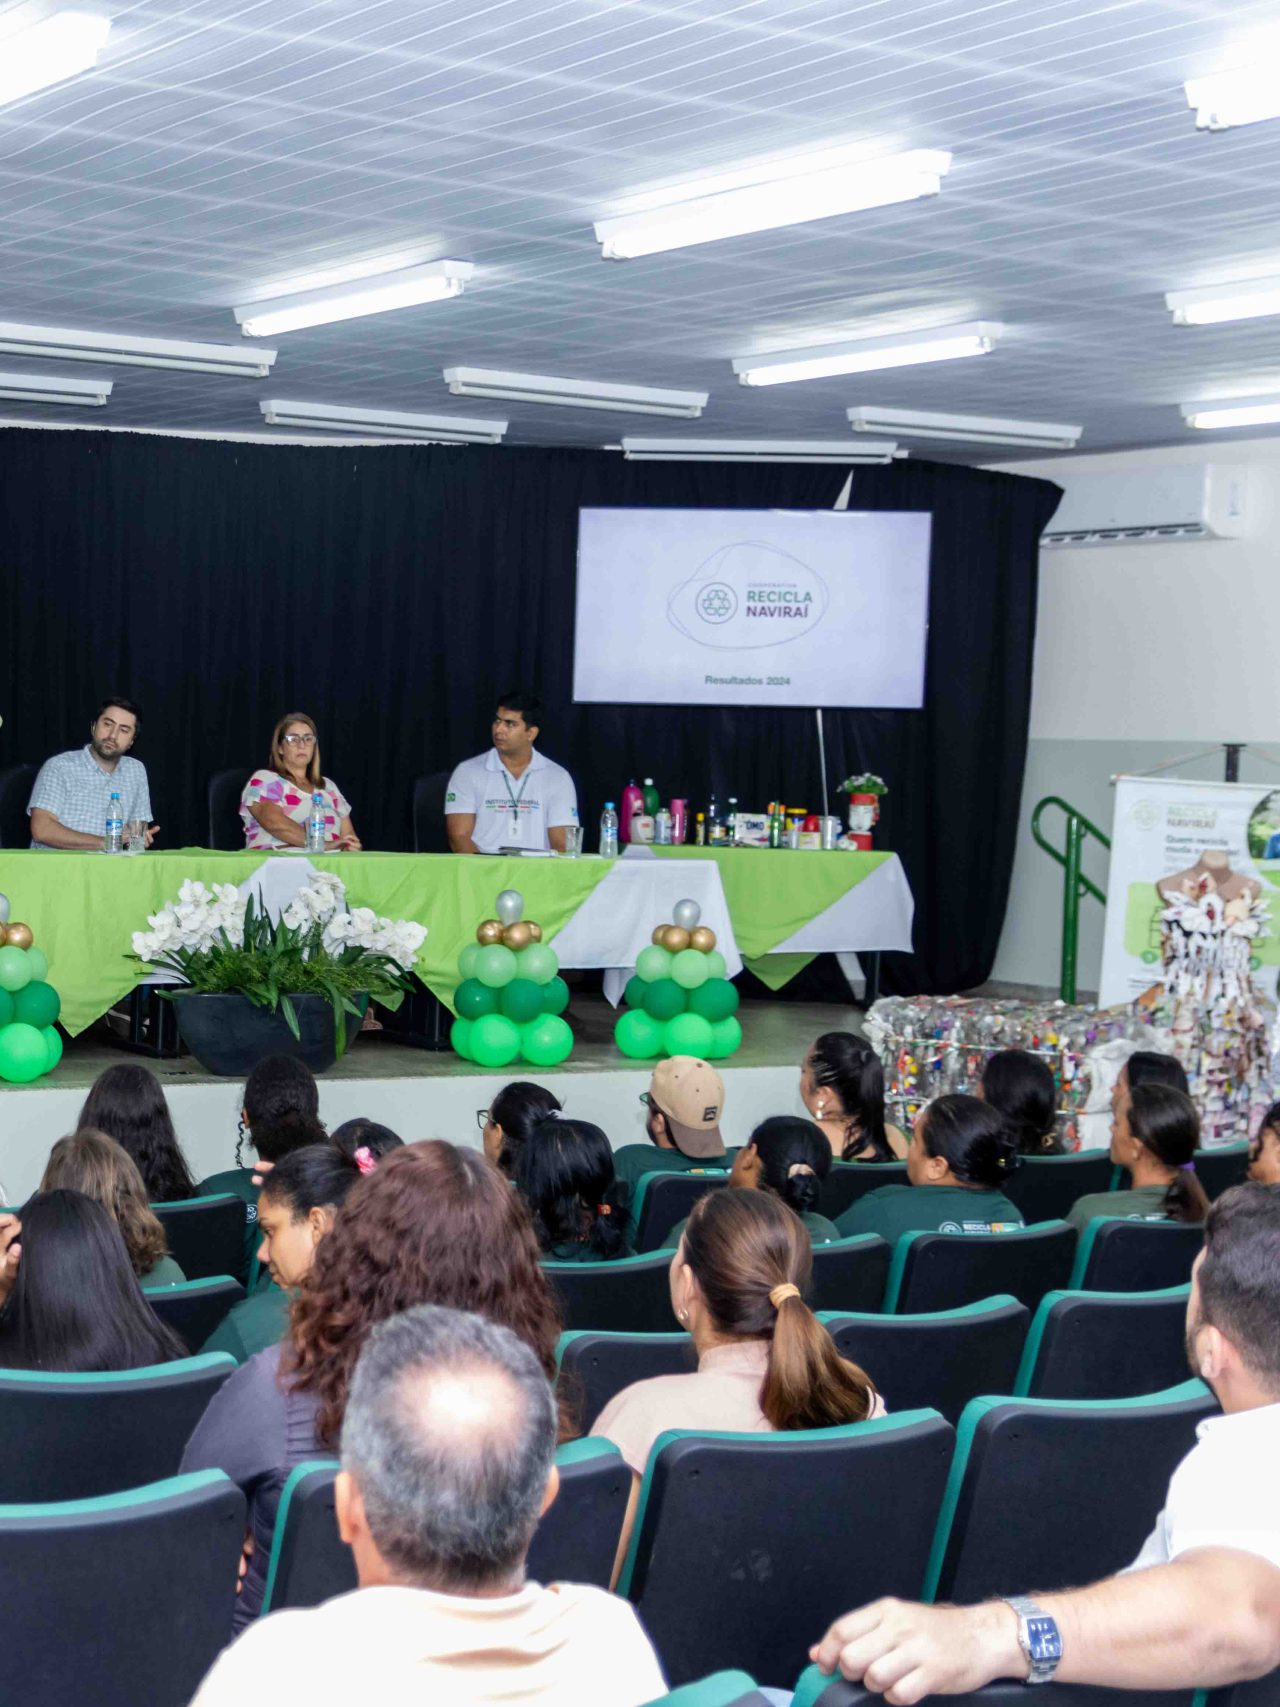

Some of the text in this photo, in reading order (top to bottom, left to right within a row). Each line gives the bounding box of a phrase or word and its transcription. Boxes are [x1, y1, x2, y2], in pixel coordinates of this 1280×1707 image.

[747, 590, 812, 603] RECICLA
[747, 604, 808, 617] NAVIRAÍ
[704, 675, 791, 686] Resultados 2024
